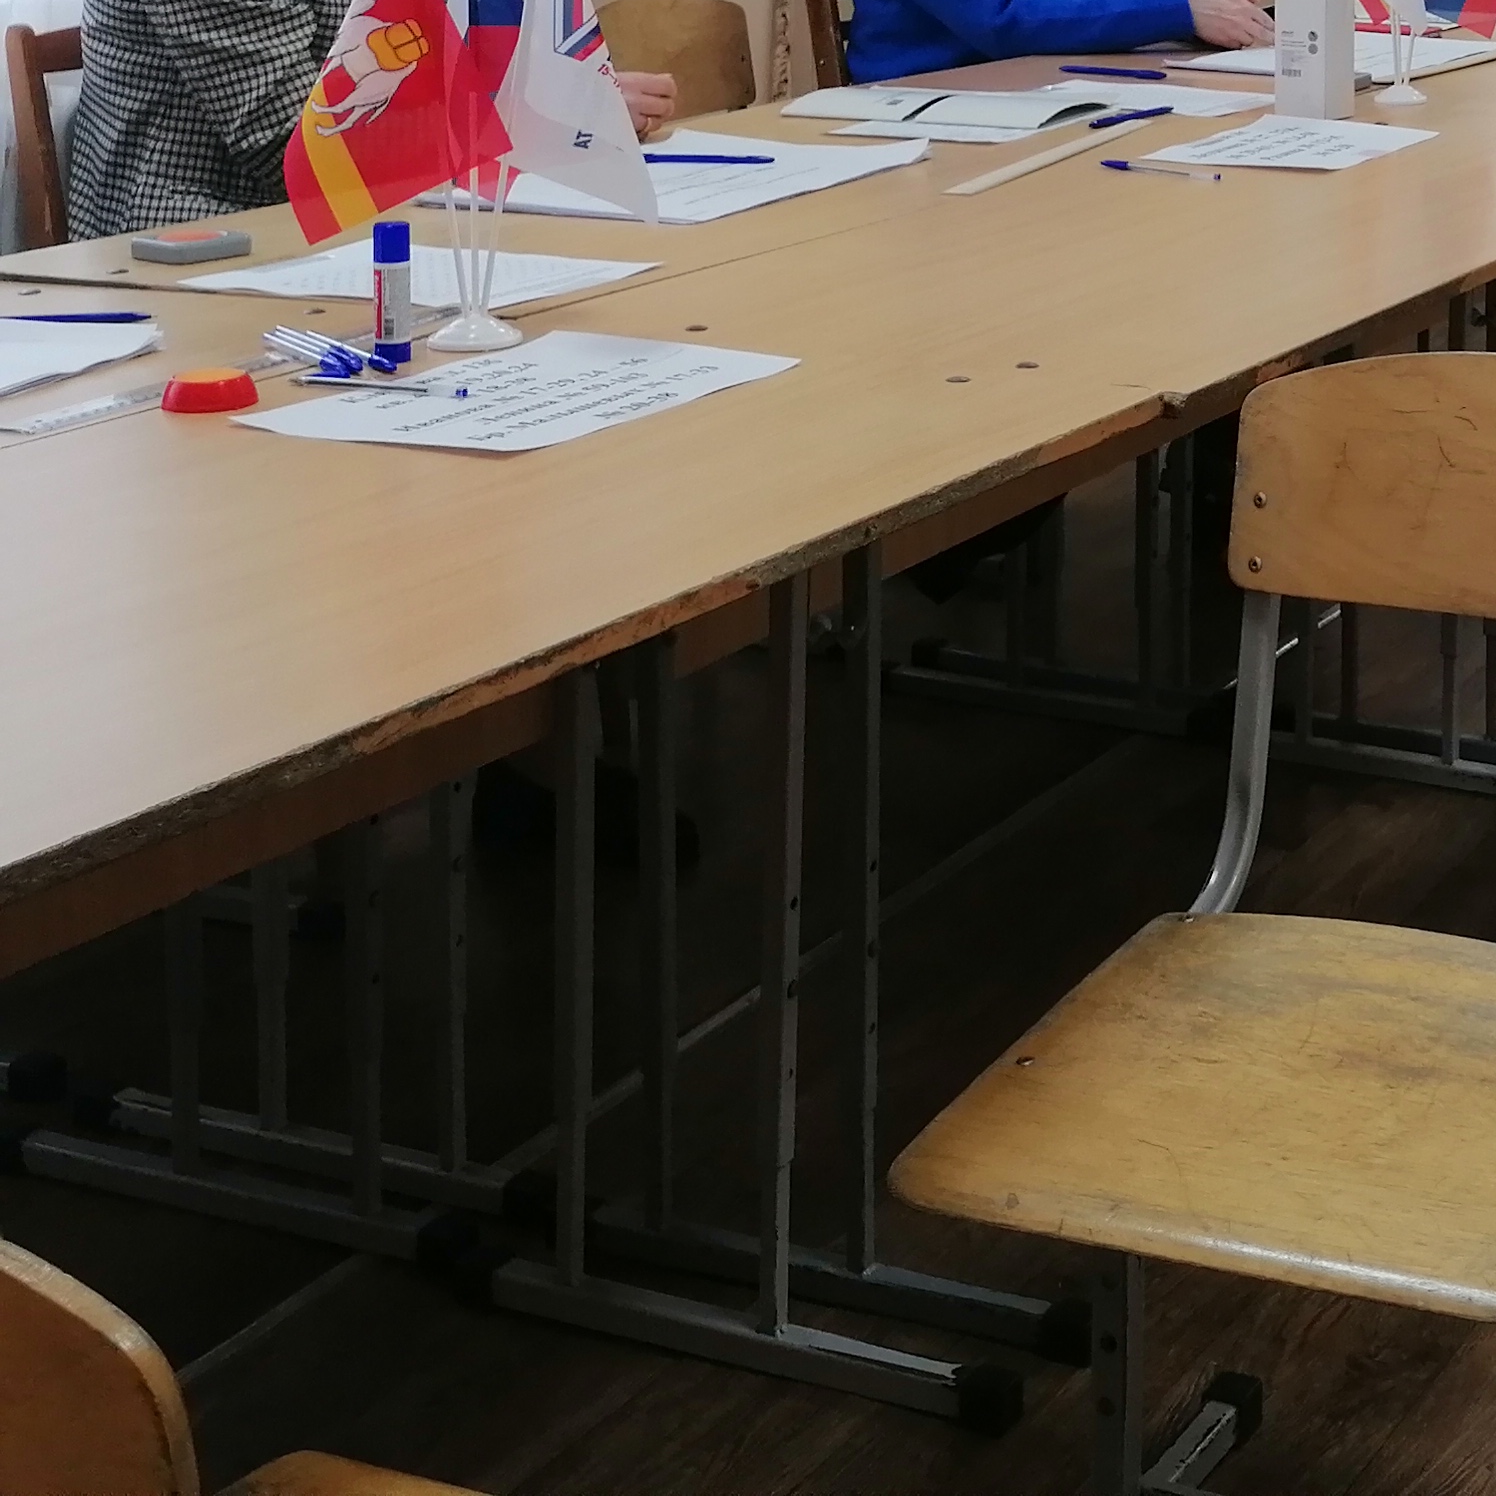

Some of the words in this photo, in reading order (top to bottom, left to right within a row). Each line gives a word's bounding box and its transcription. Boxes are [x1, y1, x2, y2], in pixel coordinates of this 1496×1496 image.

[641, 381, 670, 389] №
[492, 396, 524, 404] №
[475, 401, 560, 425] Ленина
[556, 392, 587, 400] №
[594, 410, 626, 419] №
